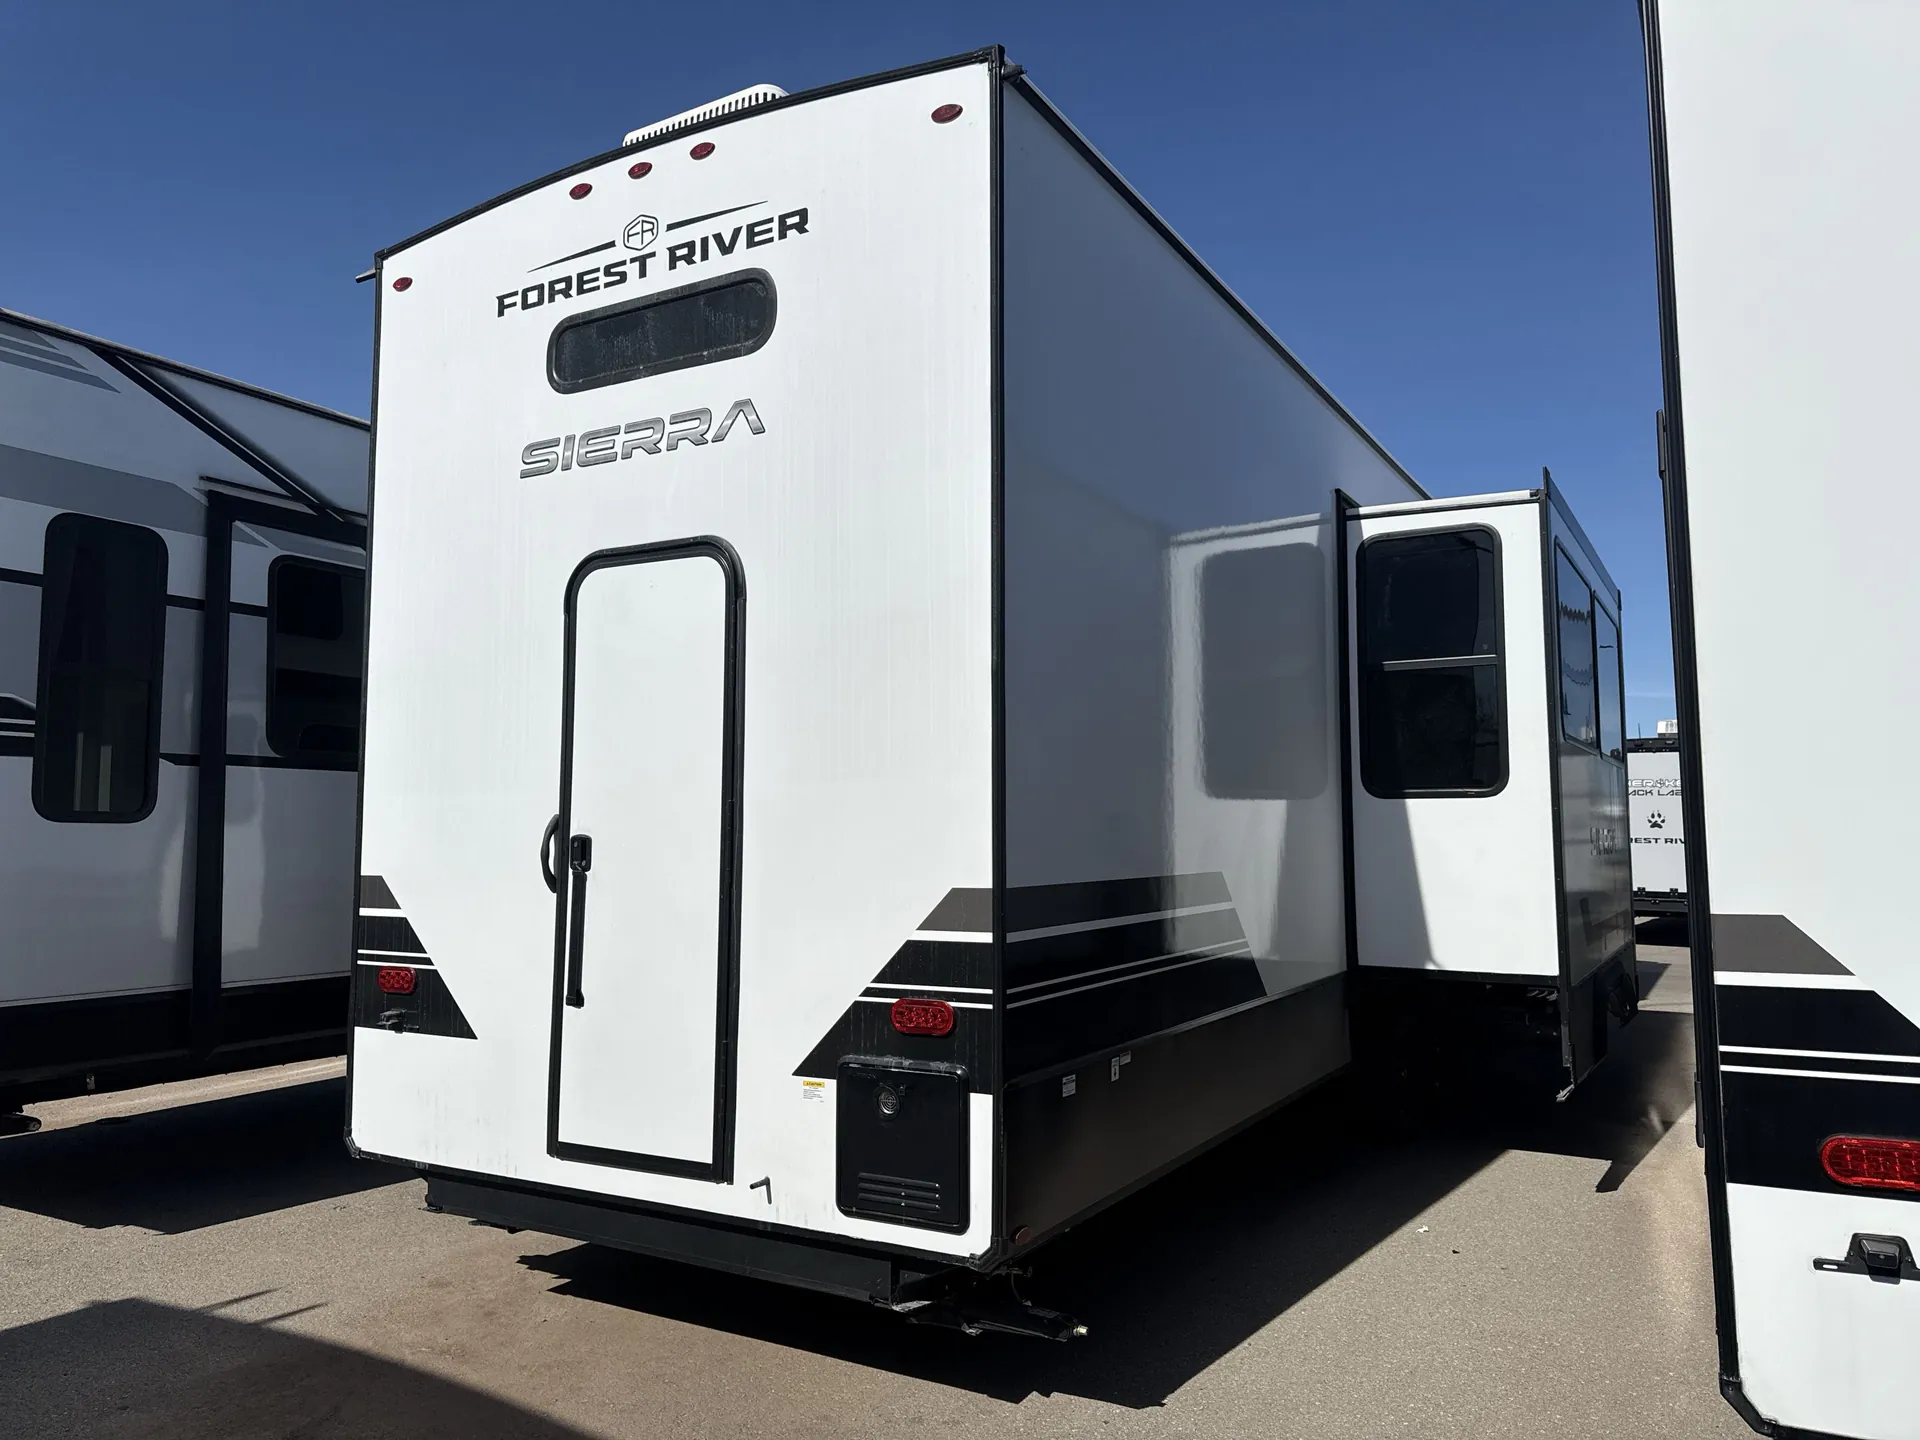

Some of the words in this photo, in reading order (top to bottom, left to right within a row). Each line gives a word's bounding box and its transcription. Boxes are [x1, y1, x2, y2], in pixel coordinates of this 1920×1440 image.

[495, 251, 656, 318] FOREST
[666, 207, 810, 271] RIVER
[520, 398, 766, 479] SIERRA
